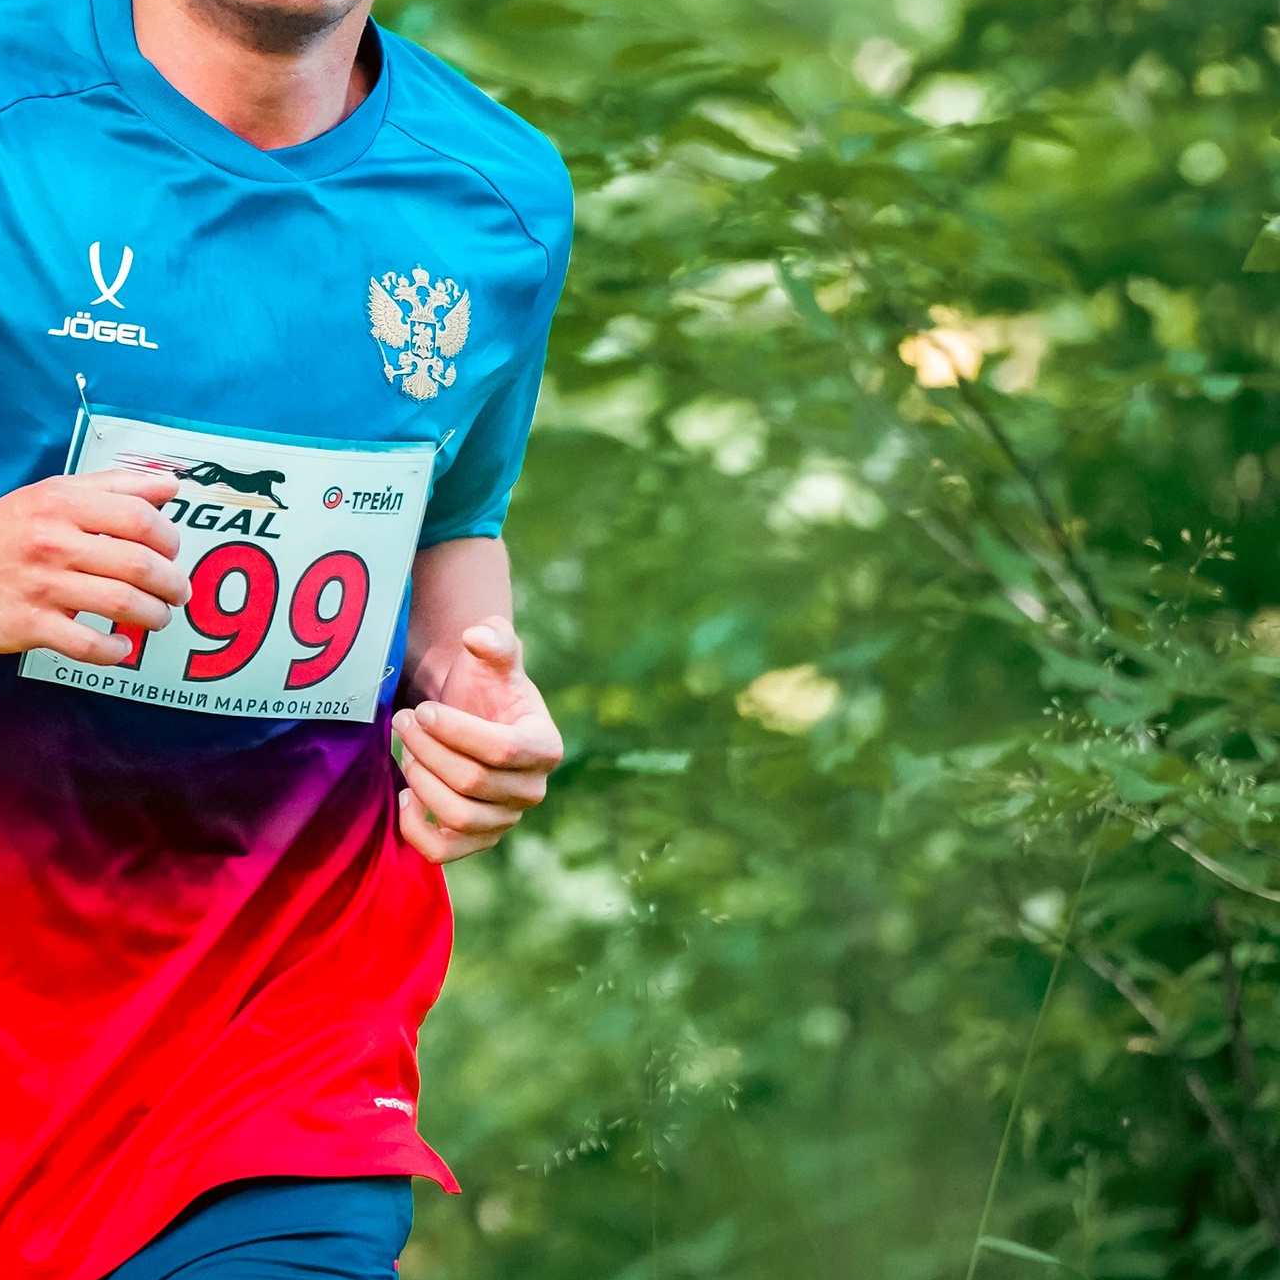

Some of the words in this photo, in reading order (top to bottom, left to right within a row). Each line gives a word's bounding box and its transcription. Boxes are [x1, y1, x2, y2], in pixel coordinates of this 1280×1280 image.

[47, 311, 159, 350] JÖGEL
[158, 498, 282, 539] OGAL
[54, 666, 208, 708] СПОРТИВНЫЙ
[214, 695, 312, 715] МАРАФОН
